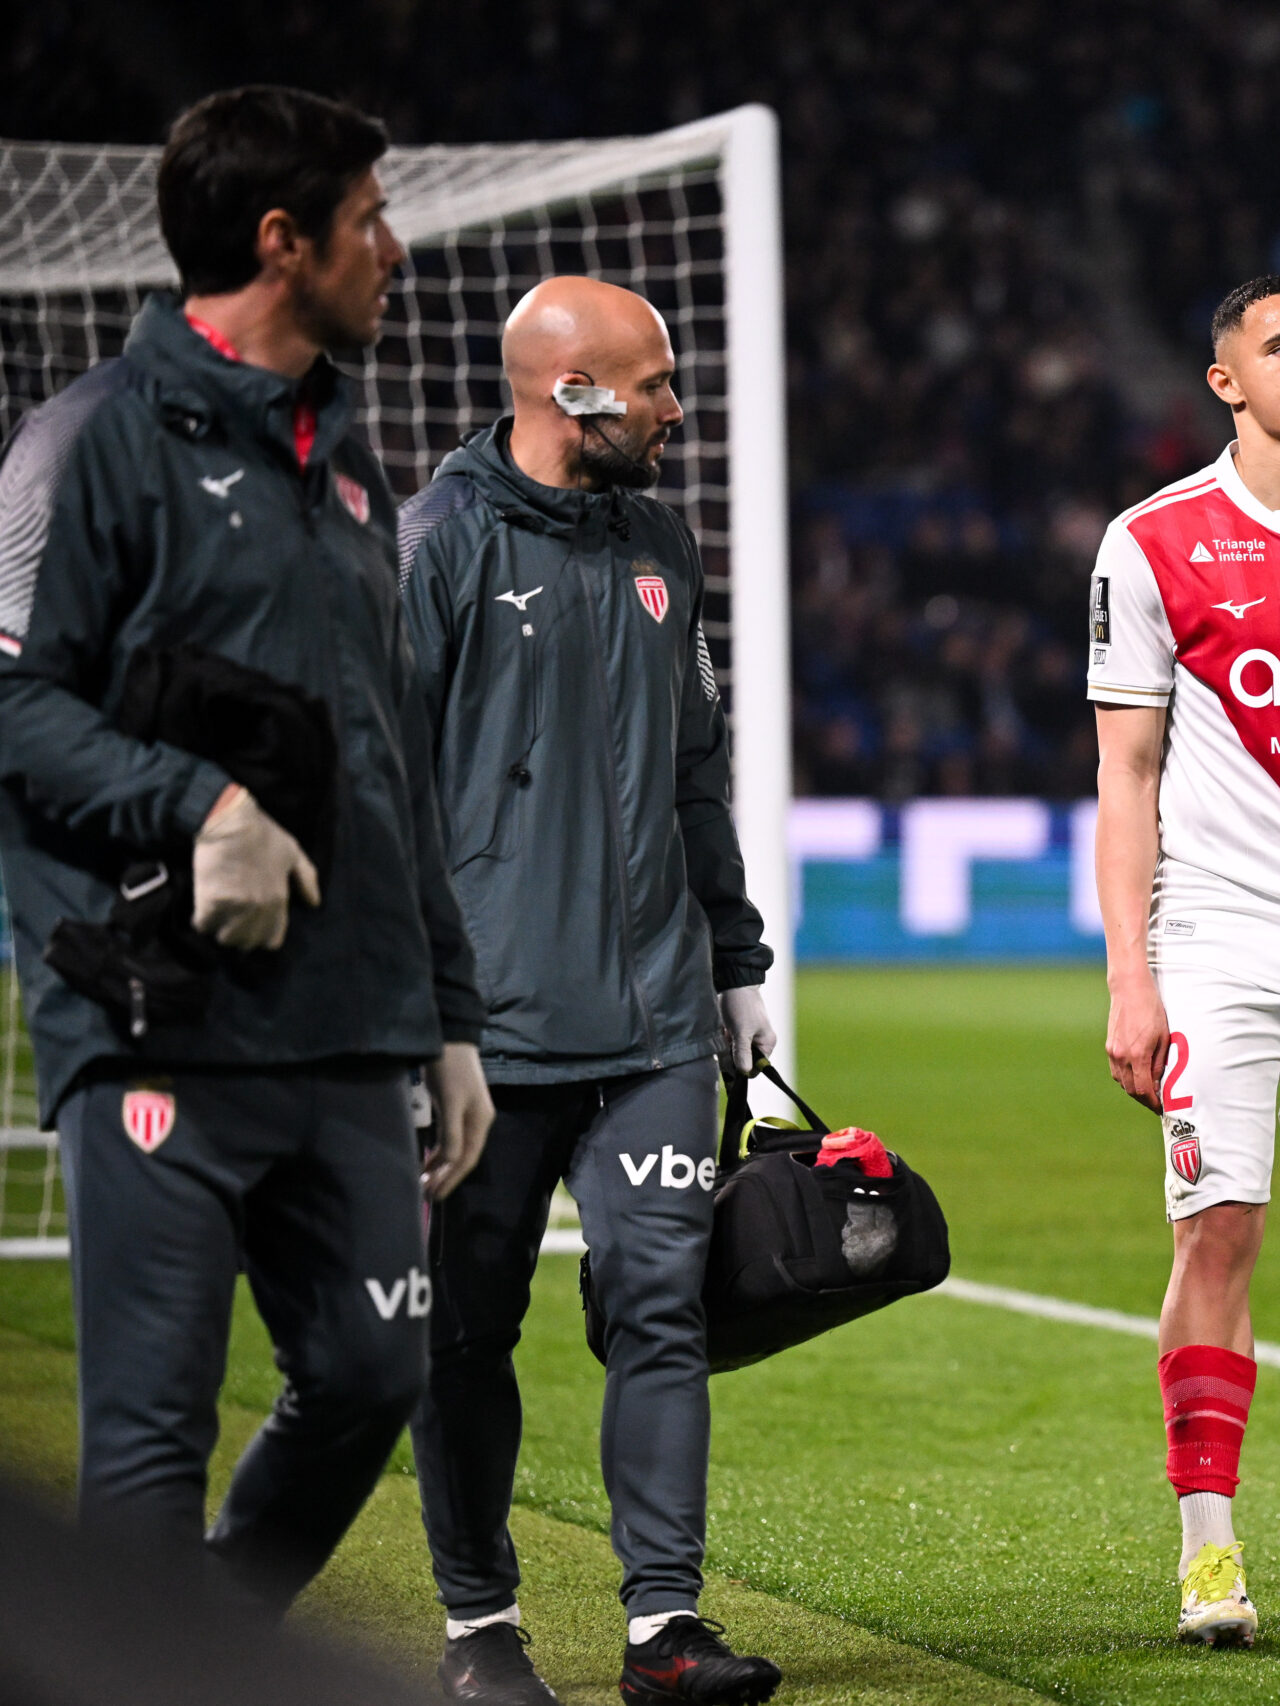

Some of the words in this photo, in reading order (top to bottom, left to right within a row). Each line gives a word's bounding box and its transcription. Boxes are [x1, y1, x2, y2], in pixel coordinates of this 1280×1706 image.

[1212, 538, 1266, 551] Triangle
[1218, 551, 1265, 562] intérim
[1162, 1031, 1194, 1113] 2
[618, 1144, 716, 1192] vbe
